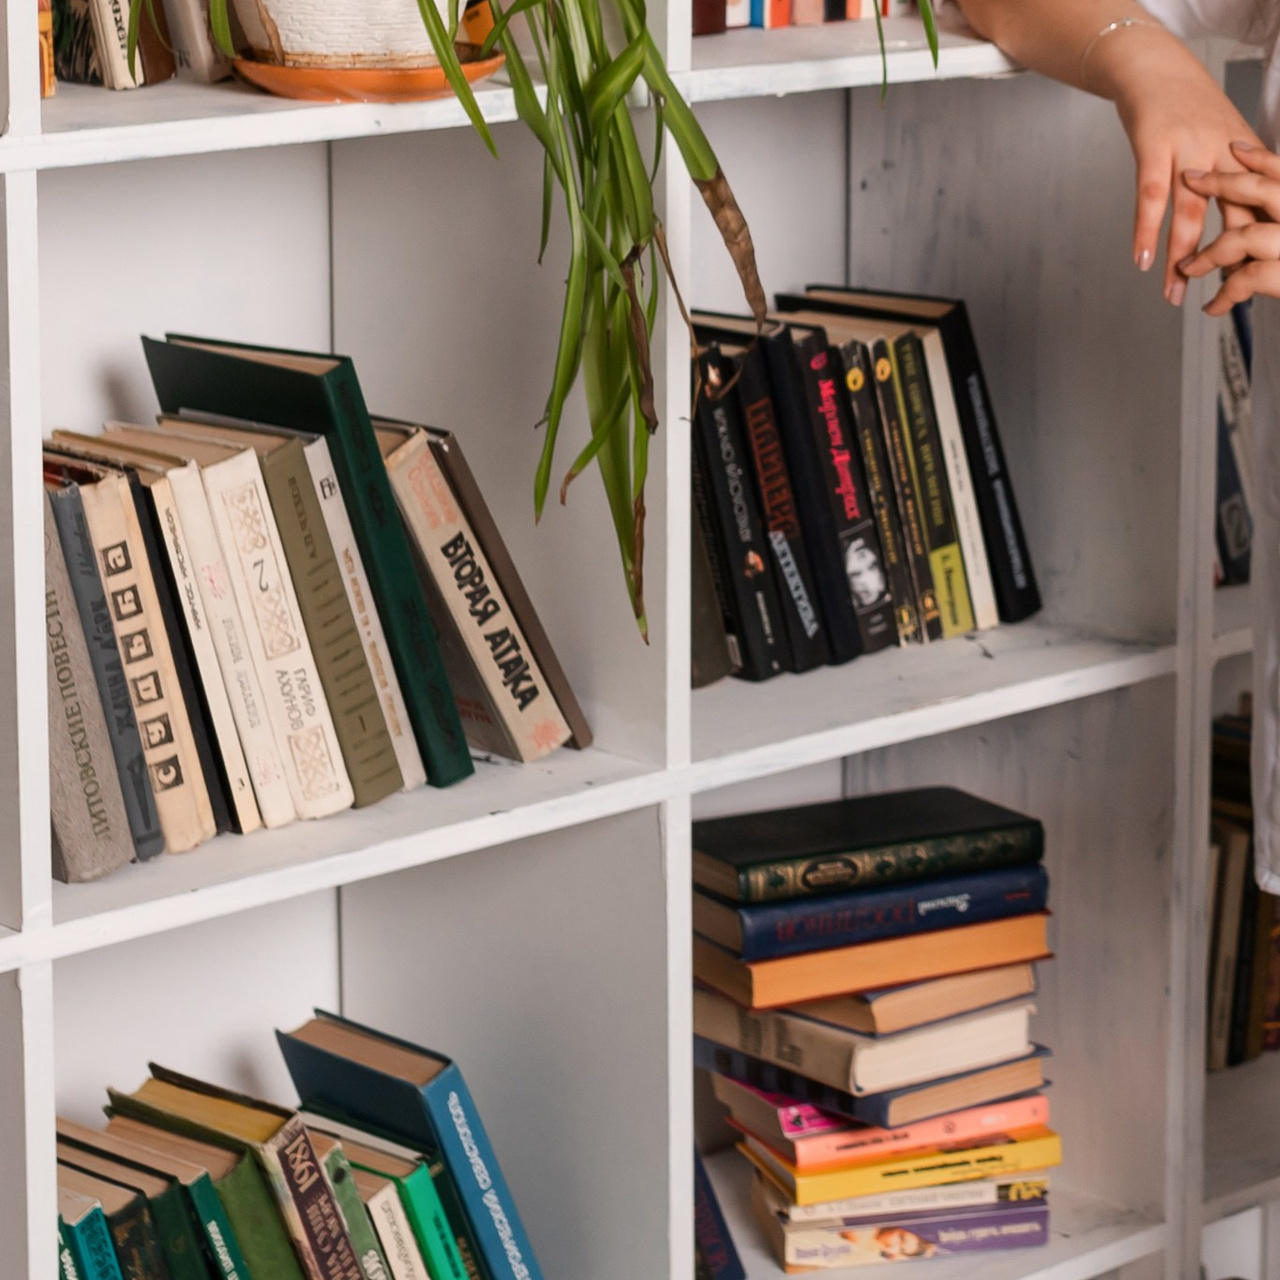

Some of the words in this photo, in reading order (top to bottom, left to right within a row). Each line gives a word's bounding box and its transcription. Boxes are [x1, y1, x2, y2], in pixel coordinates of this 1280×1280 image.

[40, 591, 77, 697] ПОВЕСТИ
[438, 531, 502, 626] ВТОРАЯ
[482, 625, 543, 712] АТАКА
[101, 660, 136, 733] ЖАННА
[275, 667, 304, 732] АХУНОВ
[292, 667, 316, 717] ГАРИФ
[65, 703, 110, 841] ЛИТОВСКИЕ
[445, 1090, 491, 1189] СЕВАСТОПОЛЬ
[205, 1220, 234, 1272] МИХАИЛ
